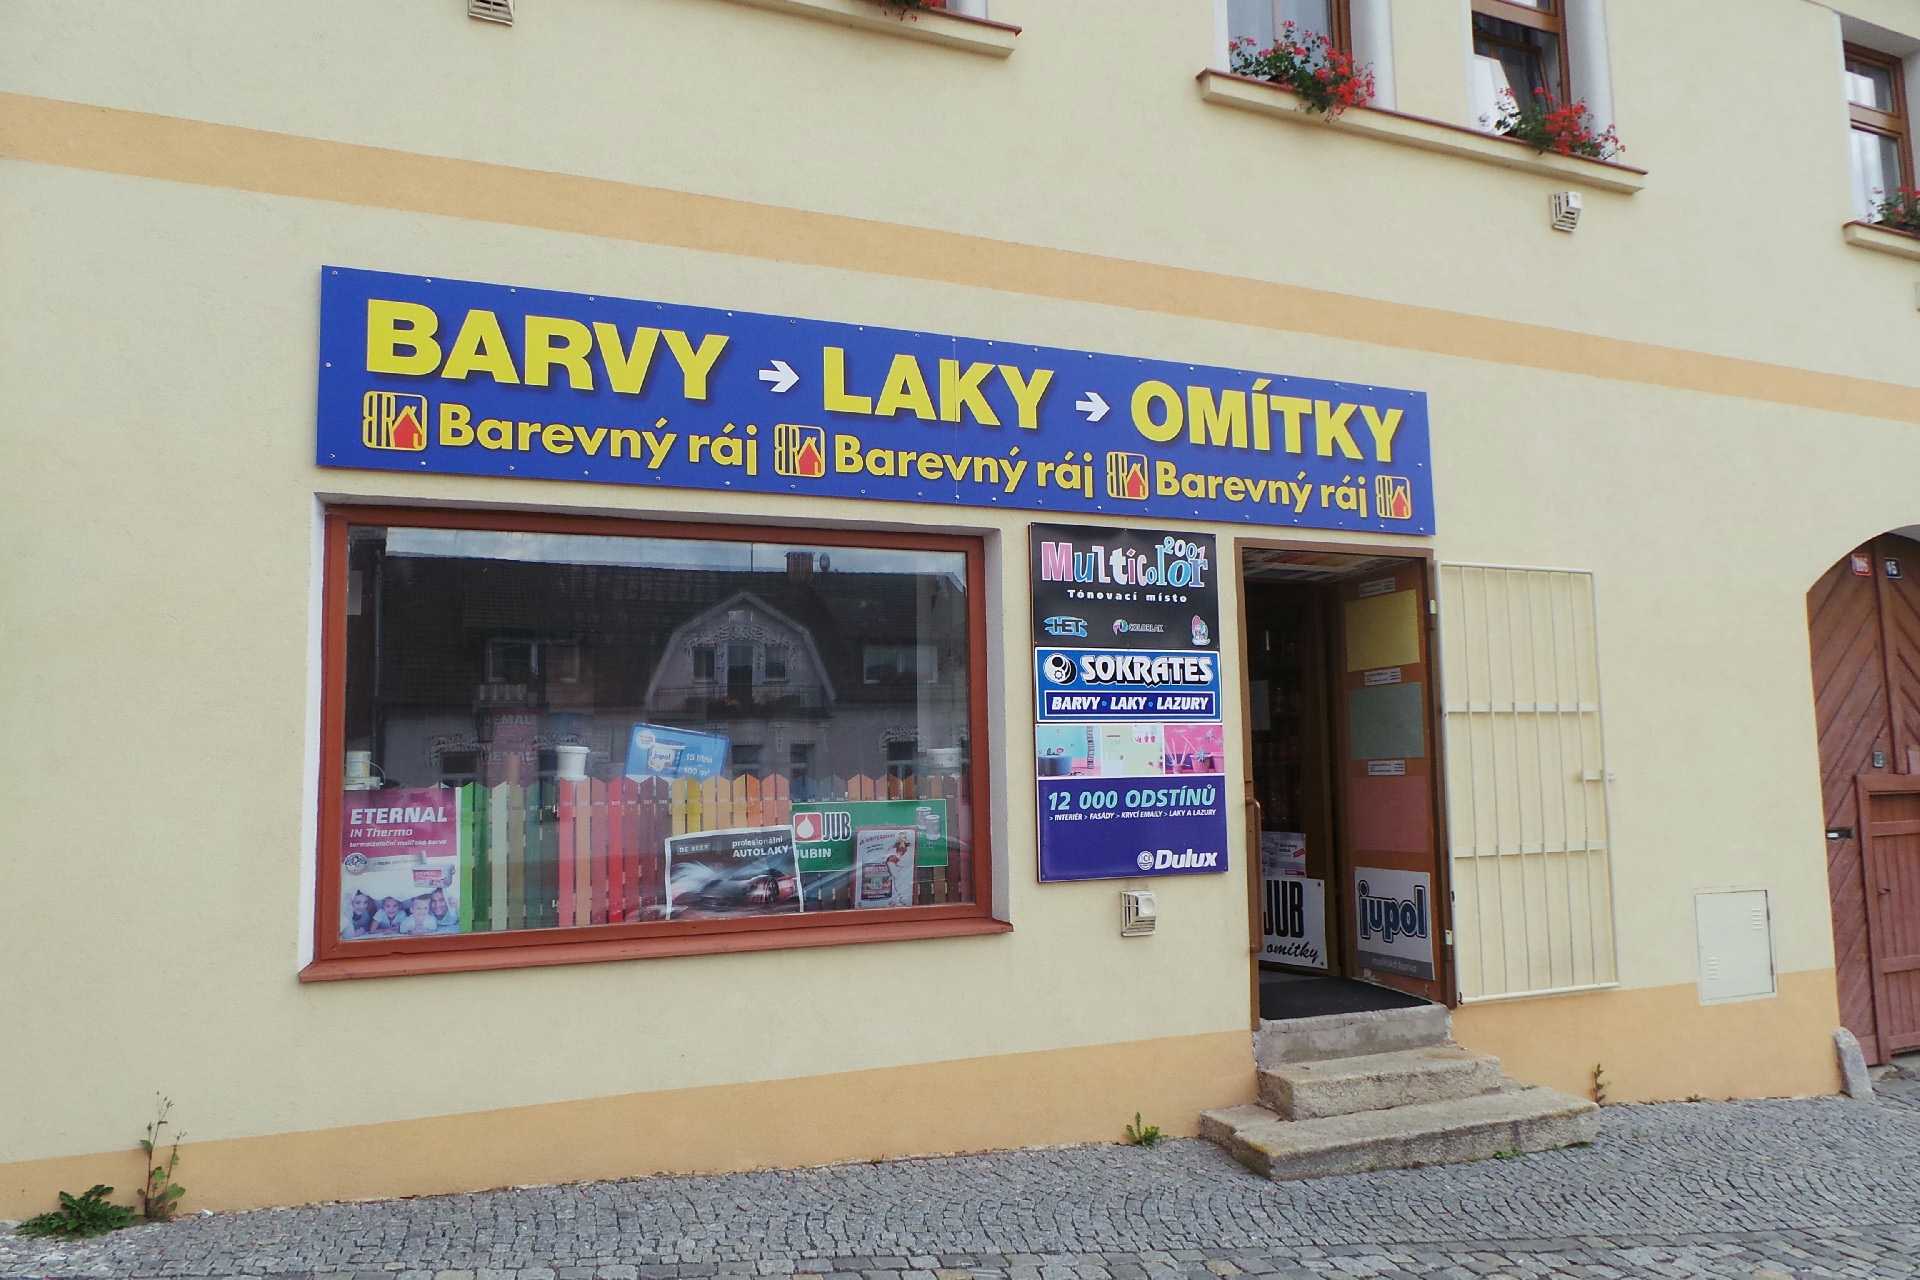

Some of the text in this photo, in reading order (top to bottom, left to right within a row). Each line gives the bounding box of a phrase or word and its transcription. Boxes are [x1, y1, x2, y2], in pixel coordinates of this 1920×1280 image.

[366, 299, 729, 400] BARVY
[823, 347, 1054, 428] LAKY
[1131, 379, 1404, 462] OMÍTKY
[440, 403, 757, 475] Barevný ráj
[835, 434, 1093, 498] Barevný ráj
[1156, 462, 1367, 518] Barevný ráj
[1163, 536, 1206, 560] 2001
[1067, 589, 1187, 603] Tónovací místo
[1054, 617, 1083, 634] HET
[1080, 654, 1214, 687] SOKRATES
[1052, 696, 1209, 711] BARVY LAKY LAZURY
[1049, 784, 1216, 811] 12 000 ODSTÍNŮ
[350, 806, 447, 825] ETERNAL
[823, 812, 852, 841] JUB
[350, 828, 413, 838] IN Thermo
[732, 835, 783, 848] profesionální
[732, 845, 788, 858] AUTOLAKY
[1155, 848, 1218, 870] Dulux
[1264, 880, 1304, 938] JUB
[1358, 880, 1427, 943] jupol
